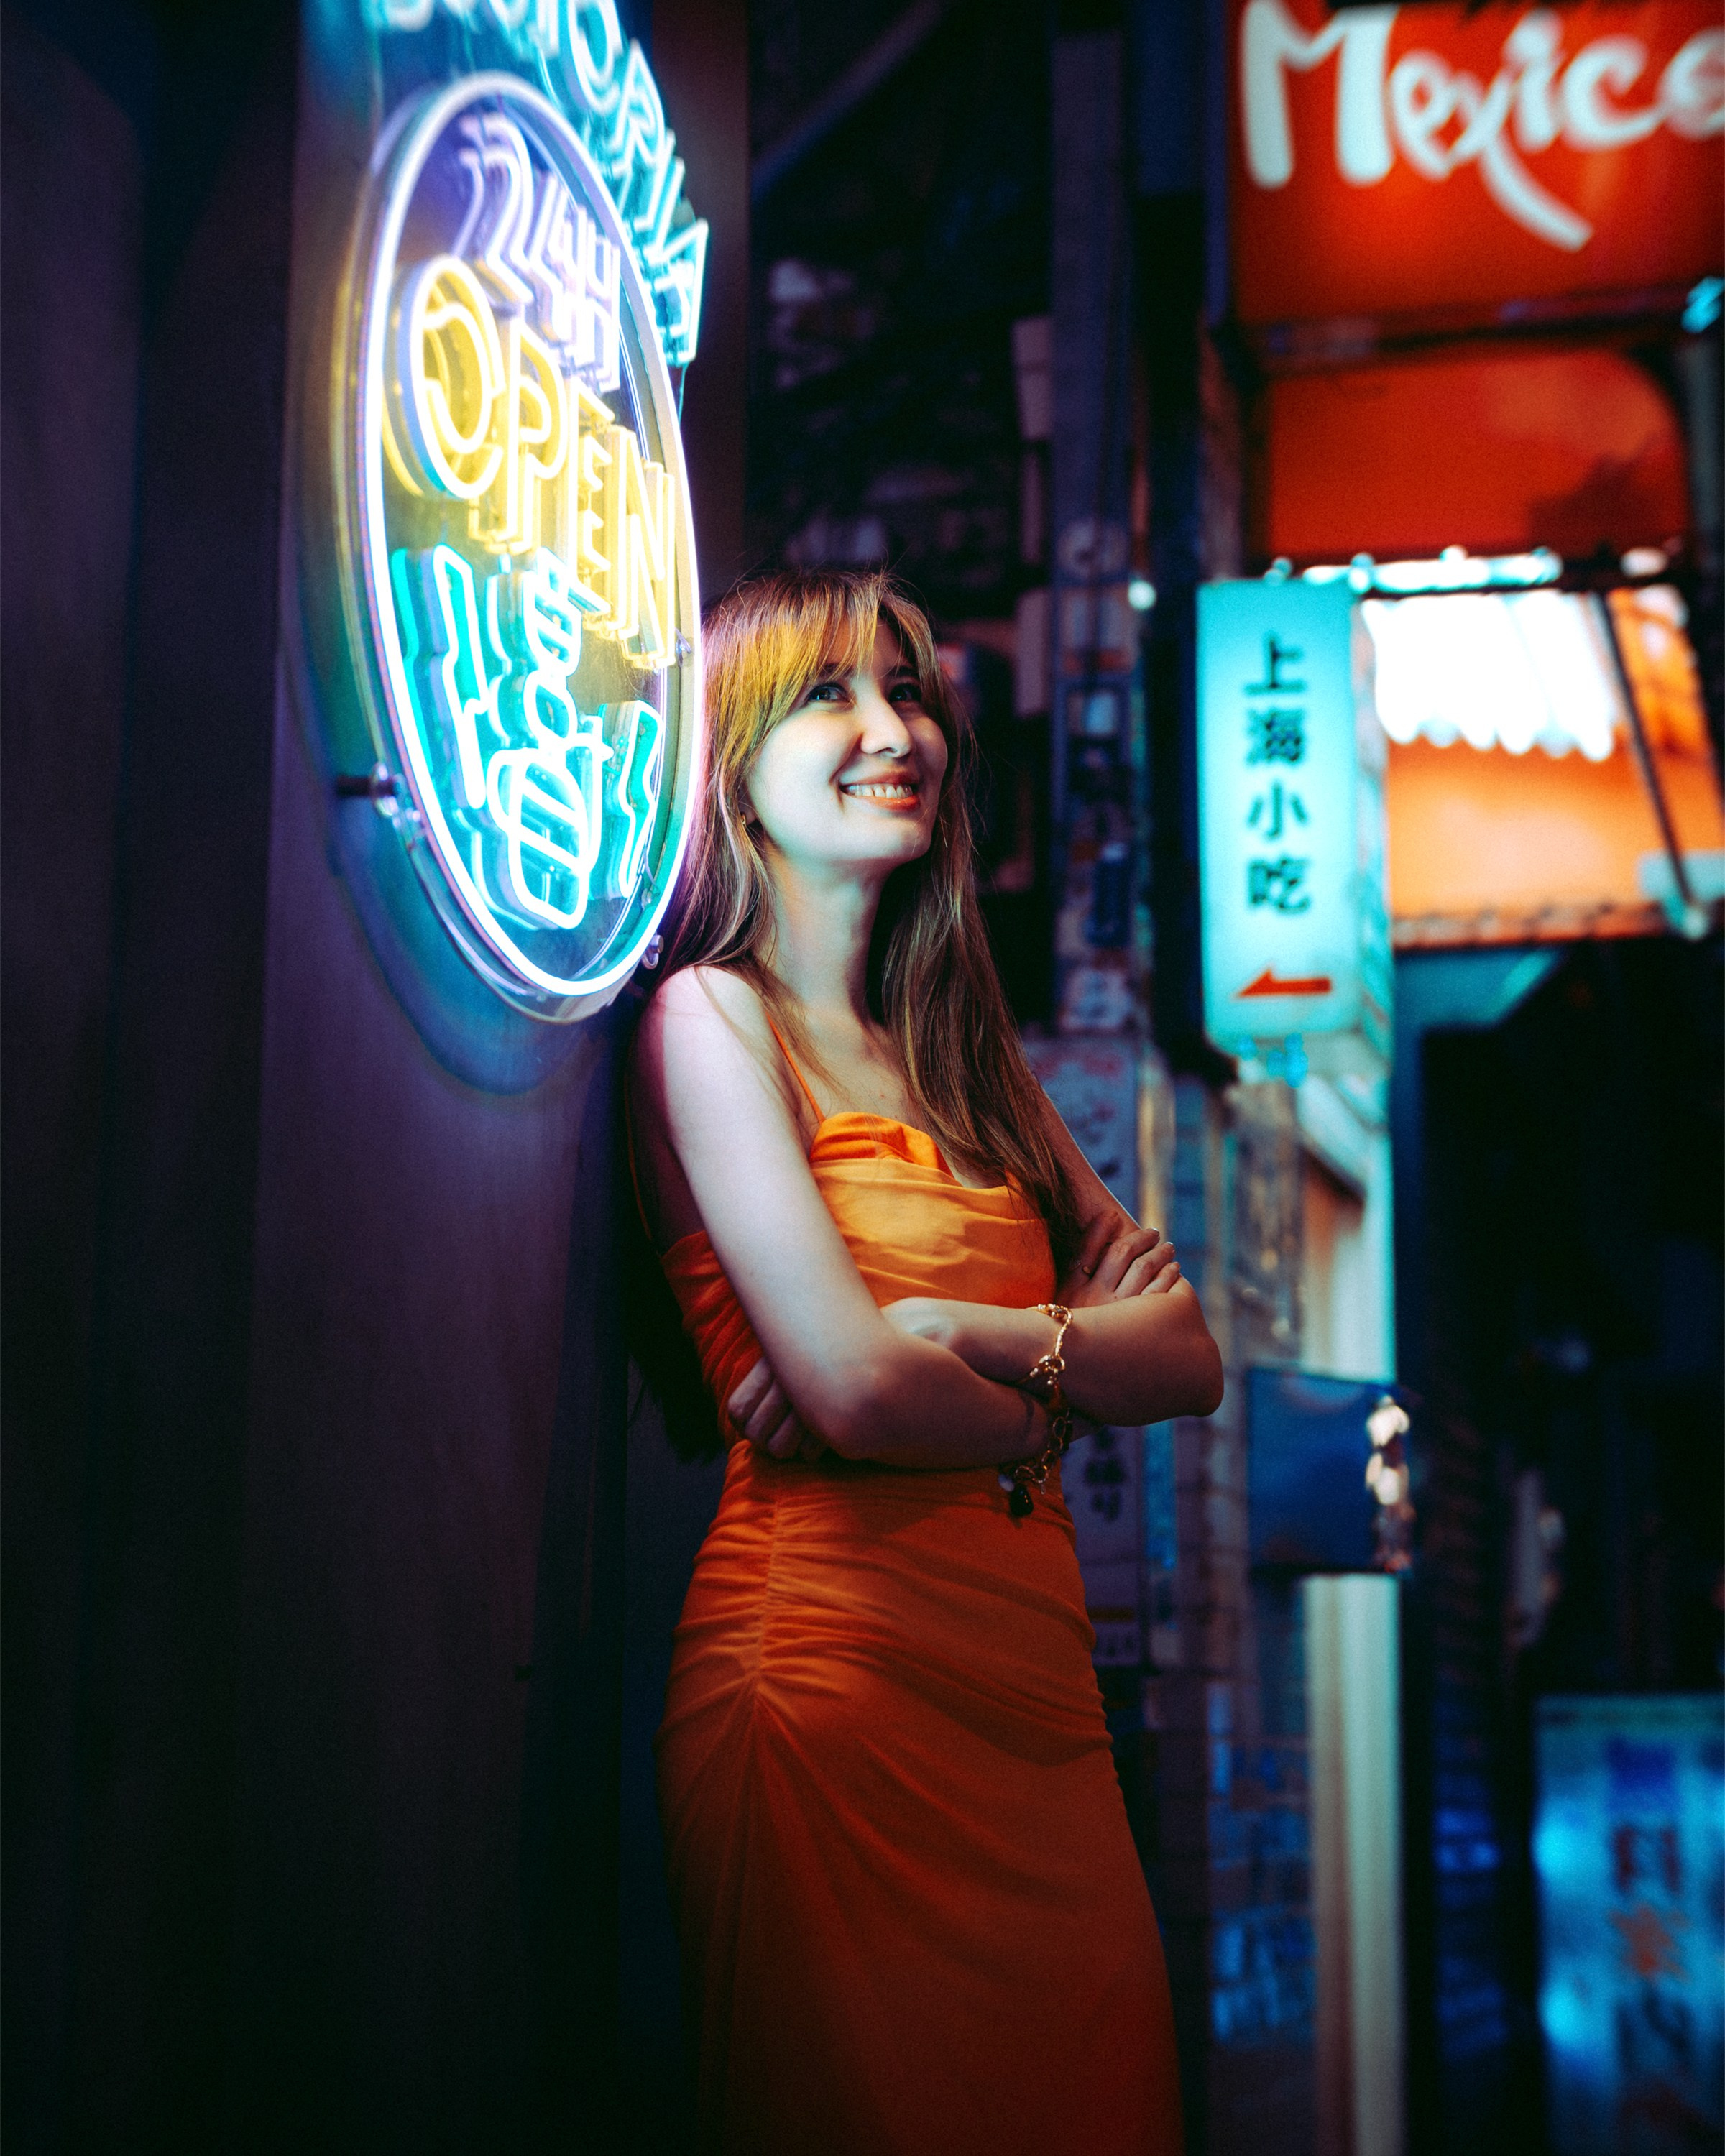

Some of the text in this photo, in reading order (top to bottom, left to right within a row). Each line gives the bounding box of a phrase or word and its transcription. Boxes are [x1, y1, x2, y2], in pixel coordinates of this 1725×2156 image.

[408, 253, 676, 669] OPEN
[1243, 630, 1311, 915] 上海小吃
